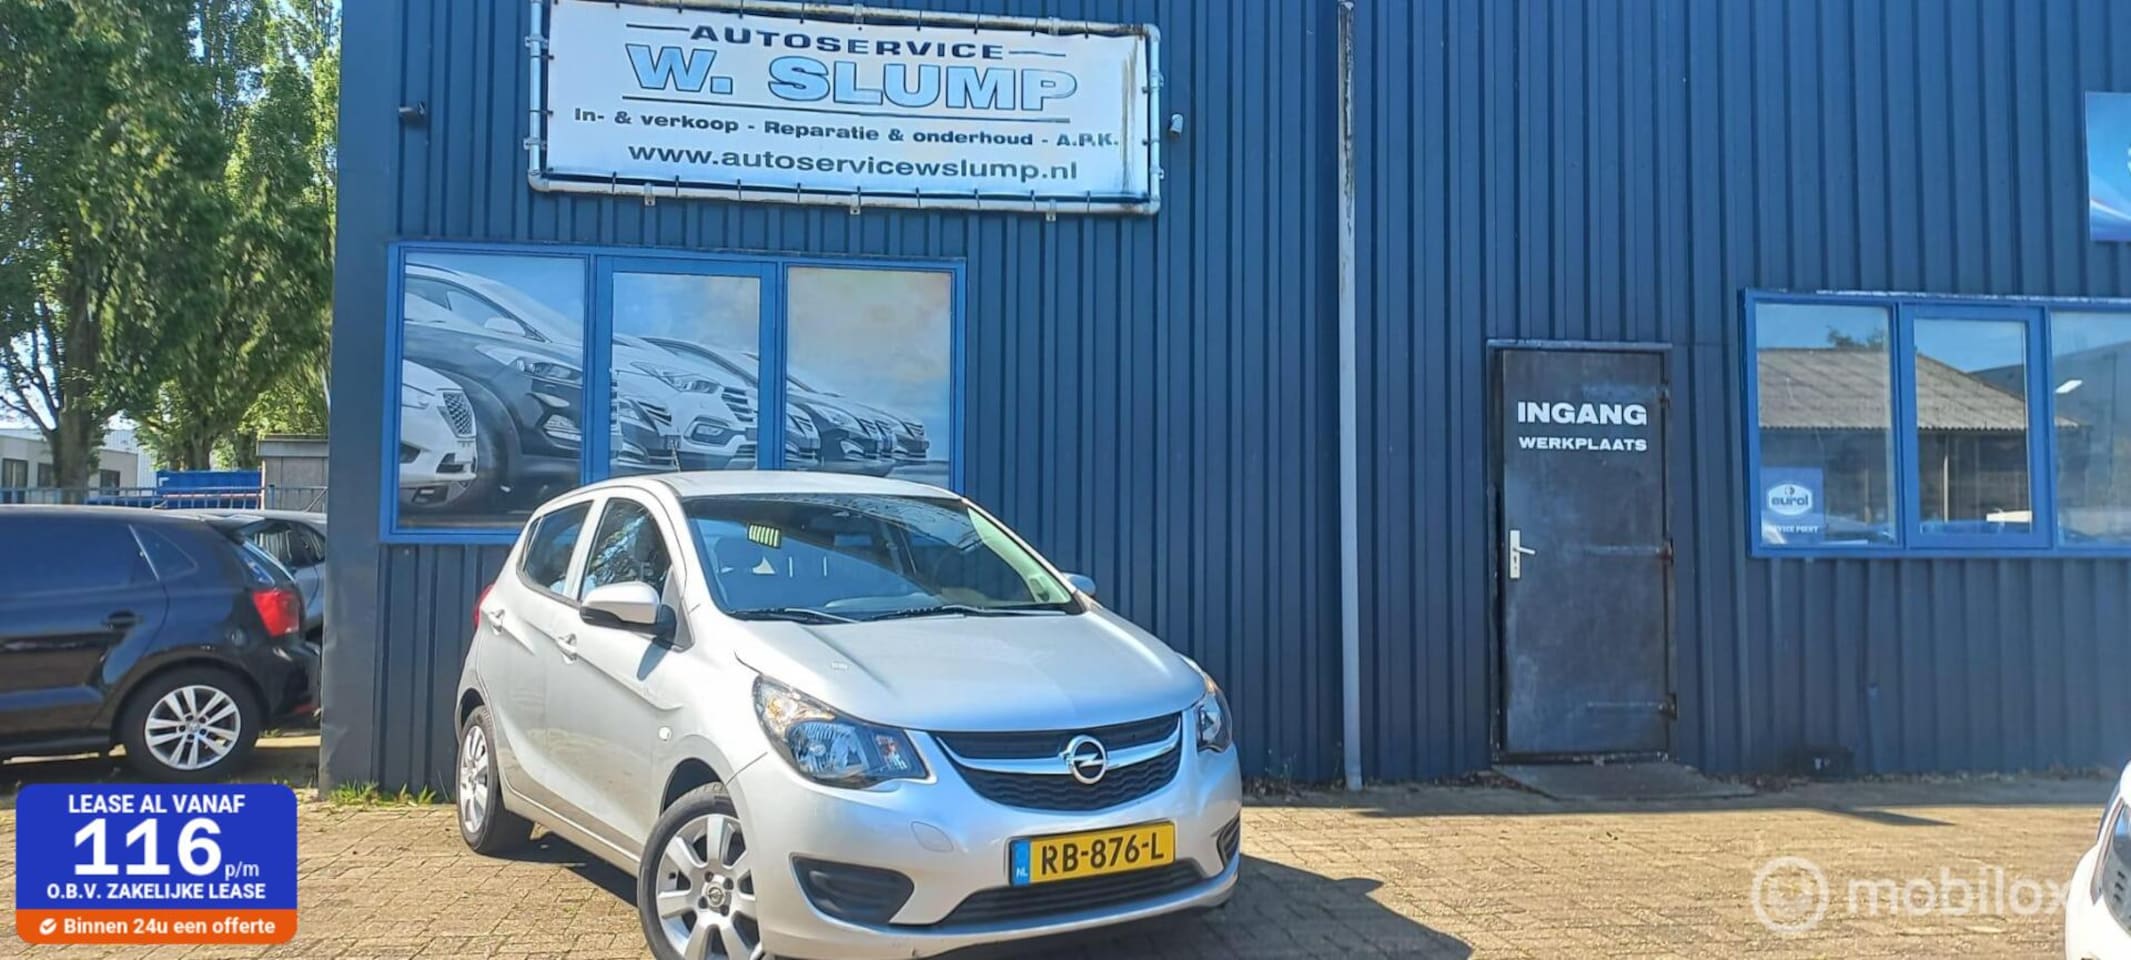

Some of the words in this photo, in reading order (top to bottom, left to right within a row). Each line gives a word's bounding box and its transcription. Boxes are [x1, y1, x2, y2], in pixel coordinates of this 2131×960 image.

[690, 25, 1004, 60] AUTOSERVICE
[625, 43, 734, 95] W.
[767, 55, 1078, 111] SLUMP
[575, 107, 604, 123] In-
[615, 110, 632, 125] &
[641, 114, 739, 133] verkoop
[764, 120, 879, 142] Reparatie
[888, 127, 905, 143] &
[913, 130, 1033, 146] onderhoud
[1056, 132, 1119, 147] A.P.K.
[629, 145, 1077, 183] www.autoservicewslump.nl
[1517, 401, 1648, 426] INGANG
[1518, 436, 1648, 452] WERKPLAATS
[1771, 495, 1809, 506] eurol
[1015, 867, 1029, 878] NL
[1041, 831, 1165, 876] RB-876-L
